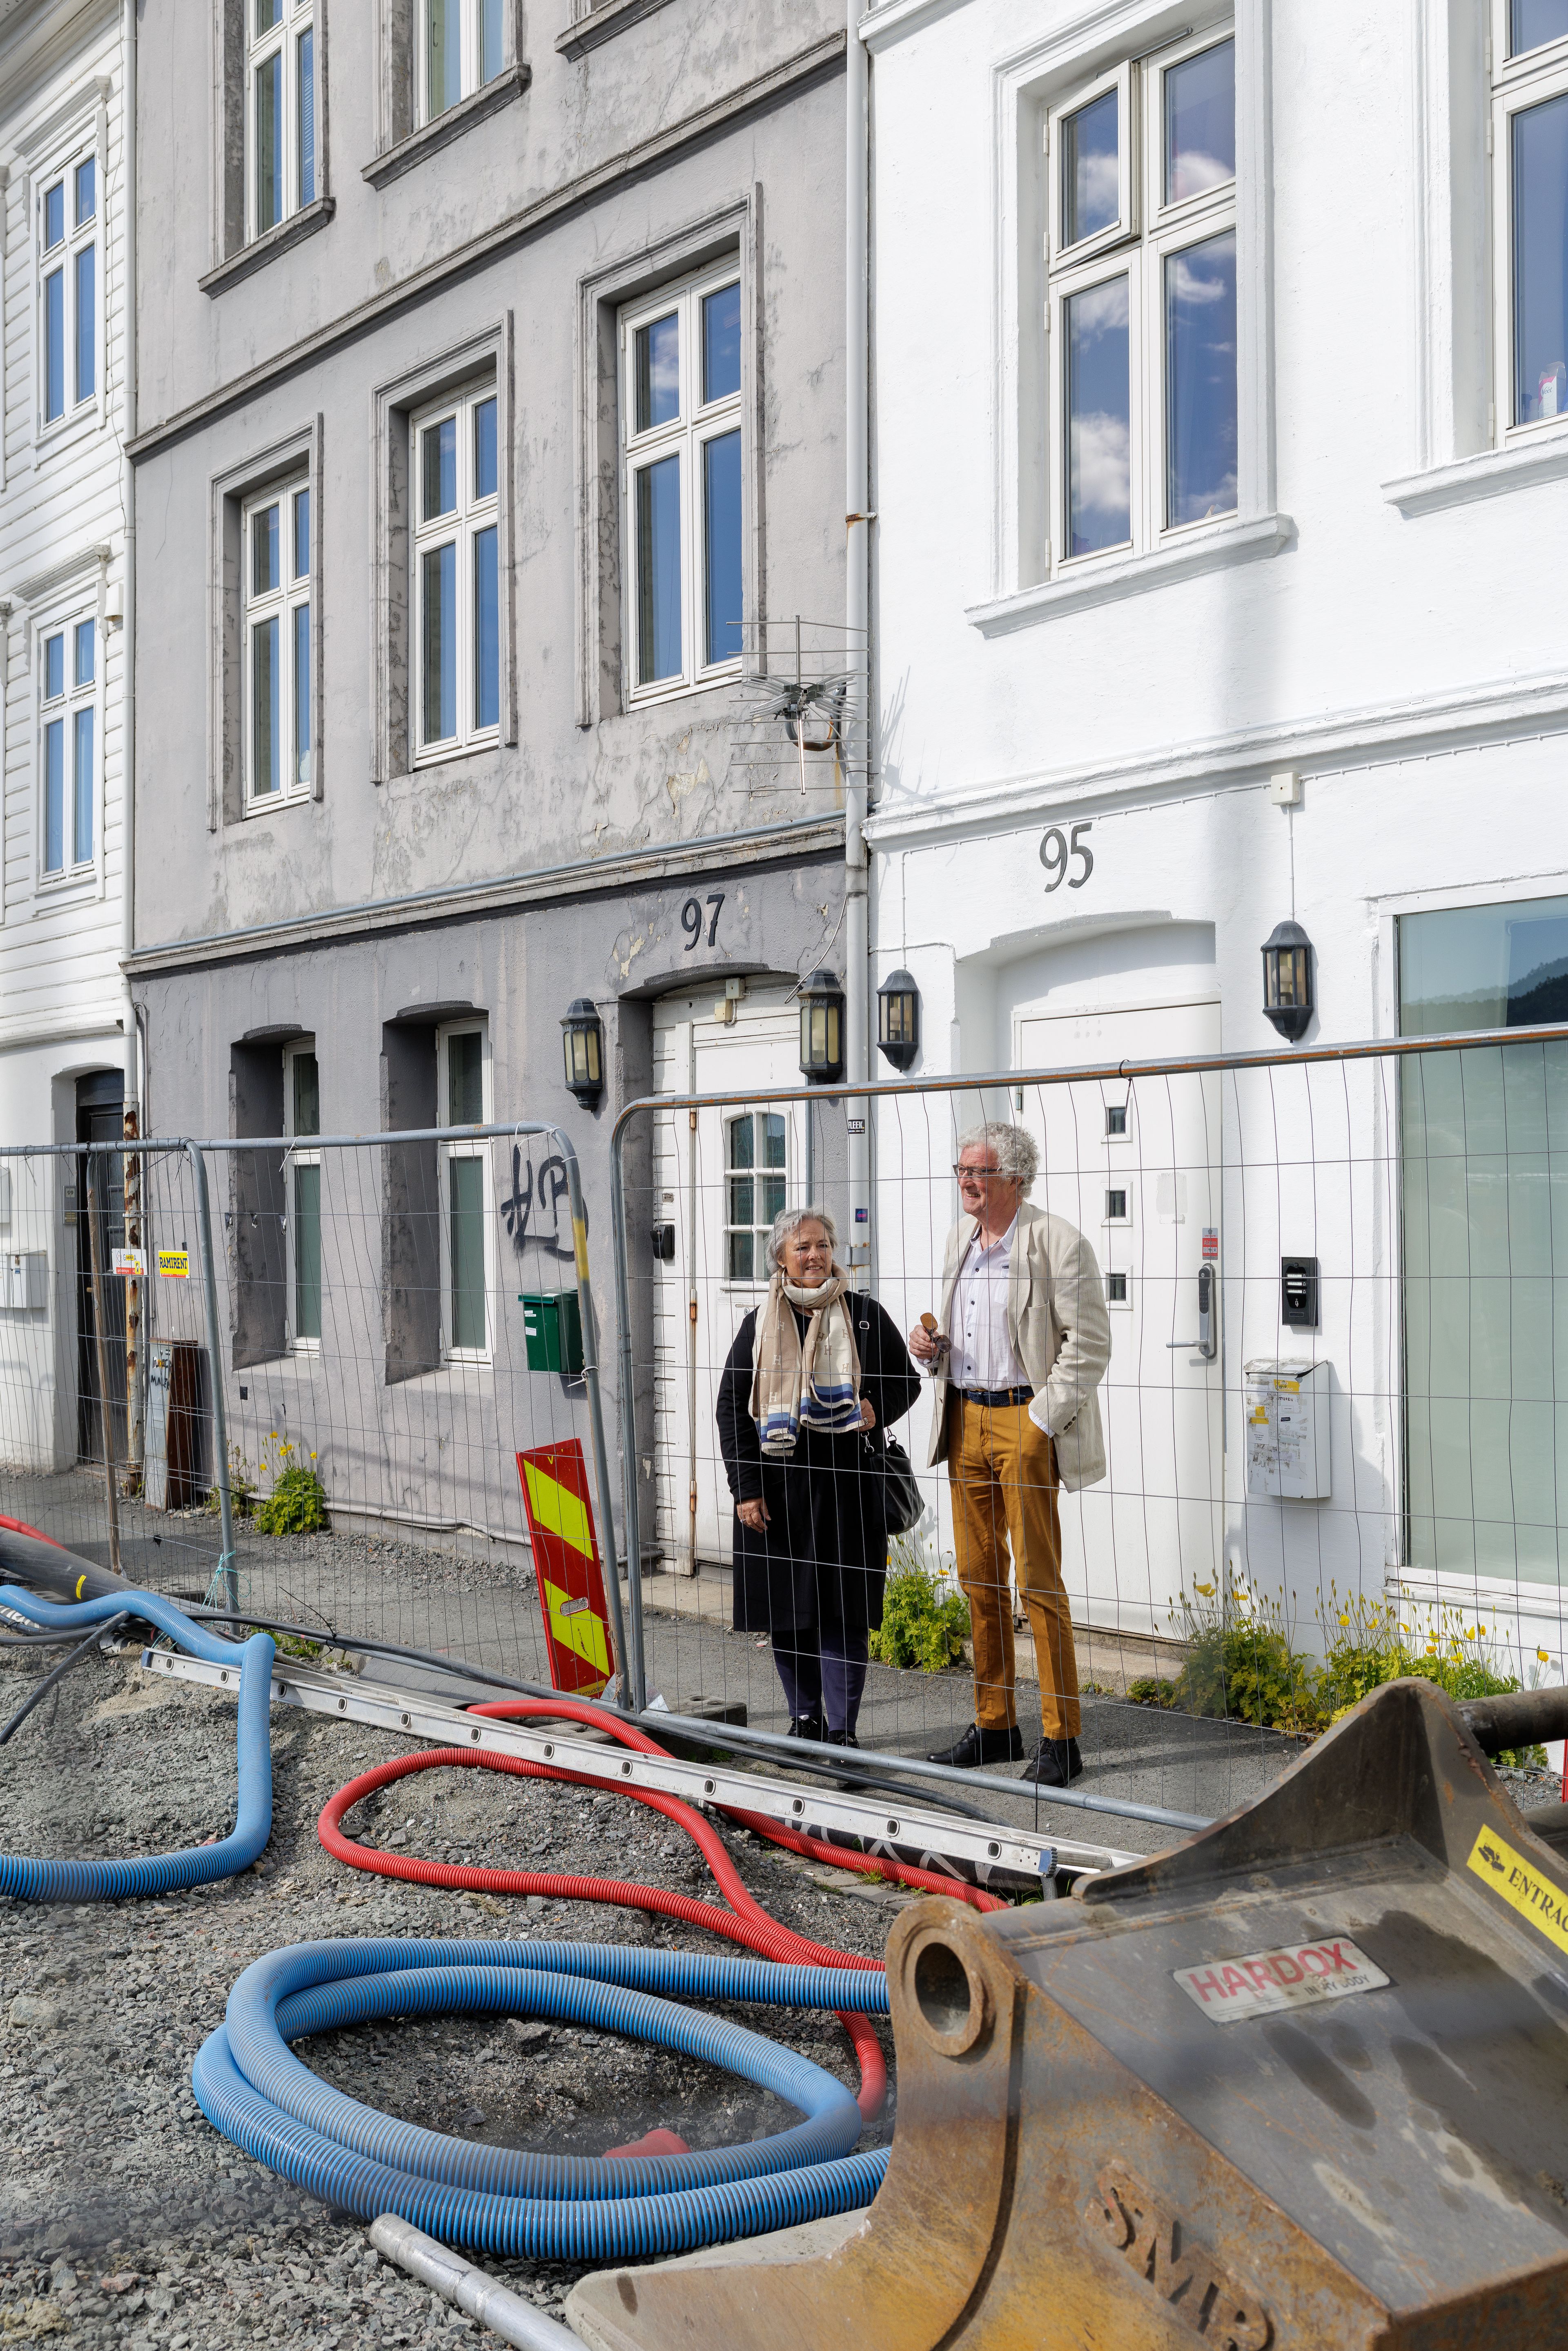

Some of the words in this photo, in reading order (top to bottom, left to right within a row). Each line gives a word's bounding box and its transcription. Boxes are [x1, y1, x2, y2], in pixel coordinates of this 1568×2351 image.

[1542, 386, 1552, 395] Veet
[1040, 822, 1094, 892] 95
[681, 893, 725, 951] 97
[159, 1257, 187, 1269] RAMIRENT
[1304, 1986, 1320, 1996] IN
